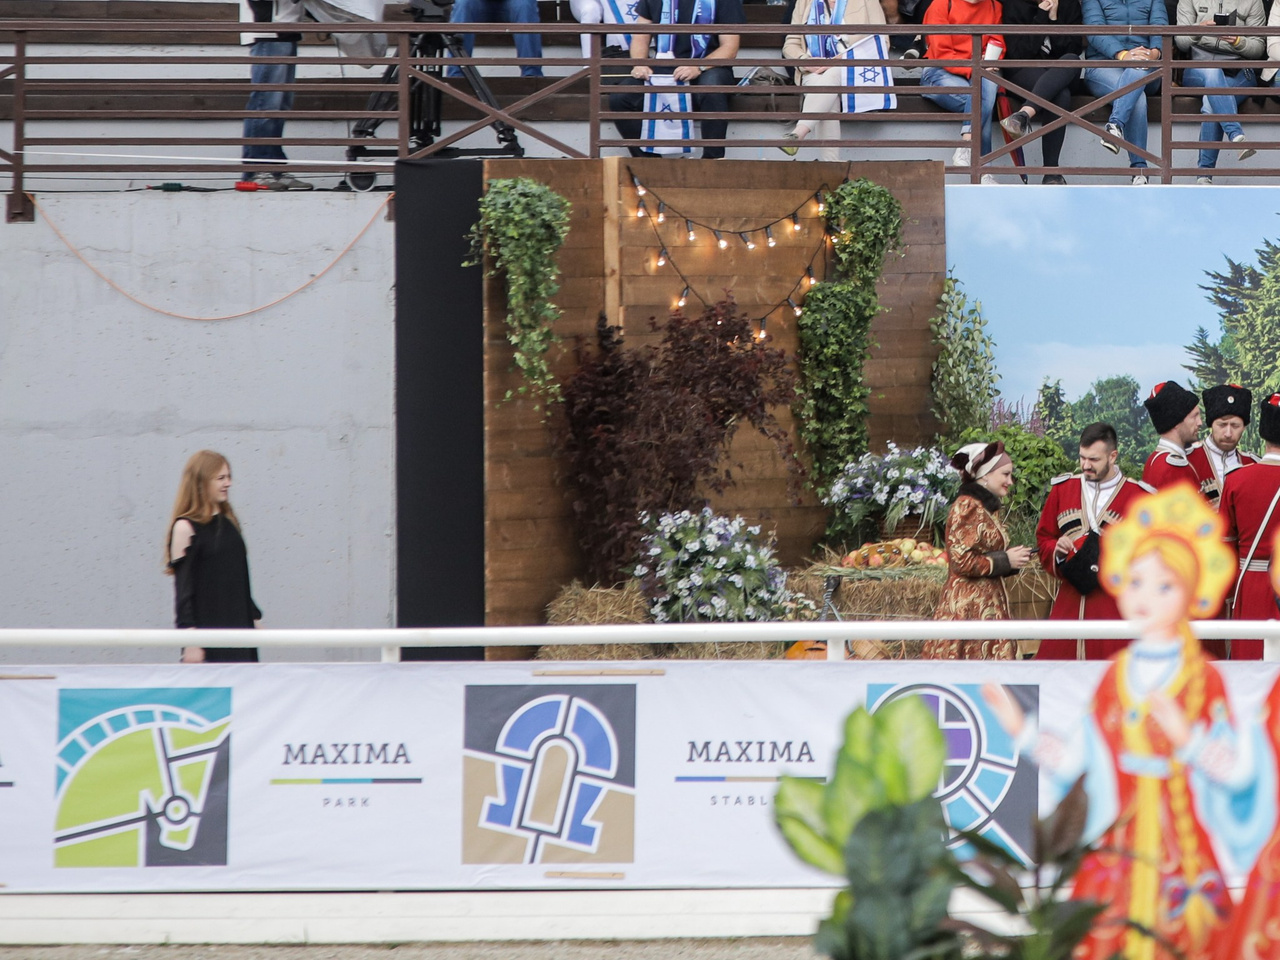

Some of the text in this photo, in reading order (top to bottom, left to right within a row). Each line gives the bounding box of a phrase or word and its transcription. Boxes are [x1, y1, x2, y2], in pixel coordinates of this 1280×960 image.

[282, 743, 412, 765] MAXIMA
[686, 741, 815, 763] MAXIMA
[322, 797, 370, 807] PARK
[710, 795, 778, 806] STABL
